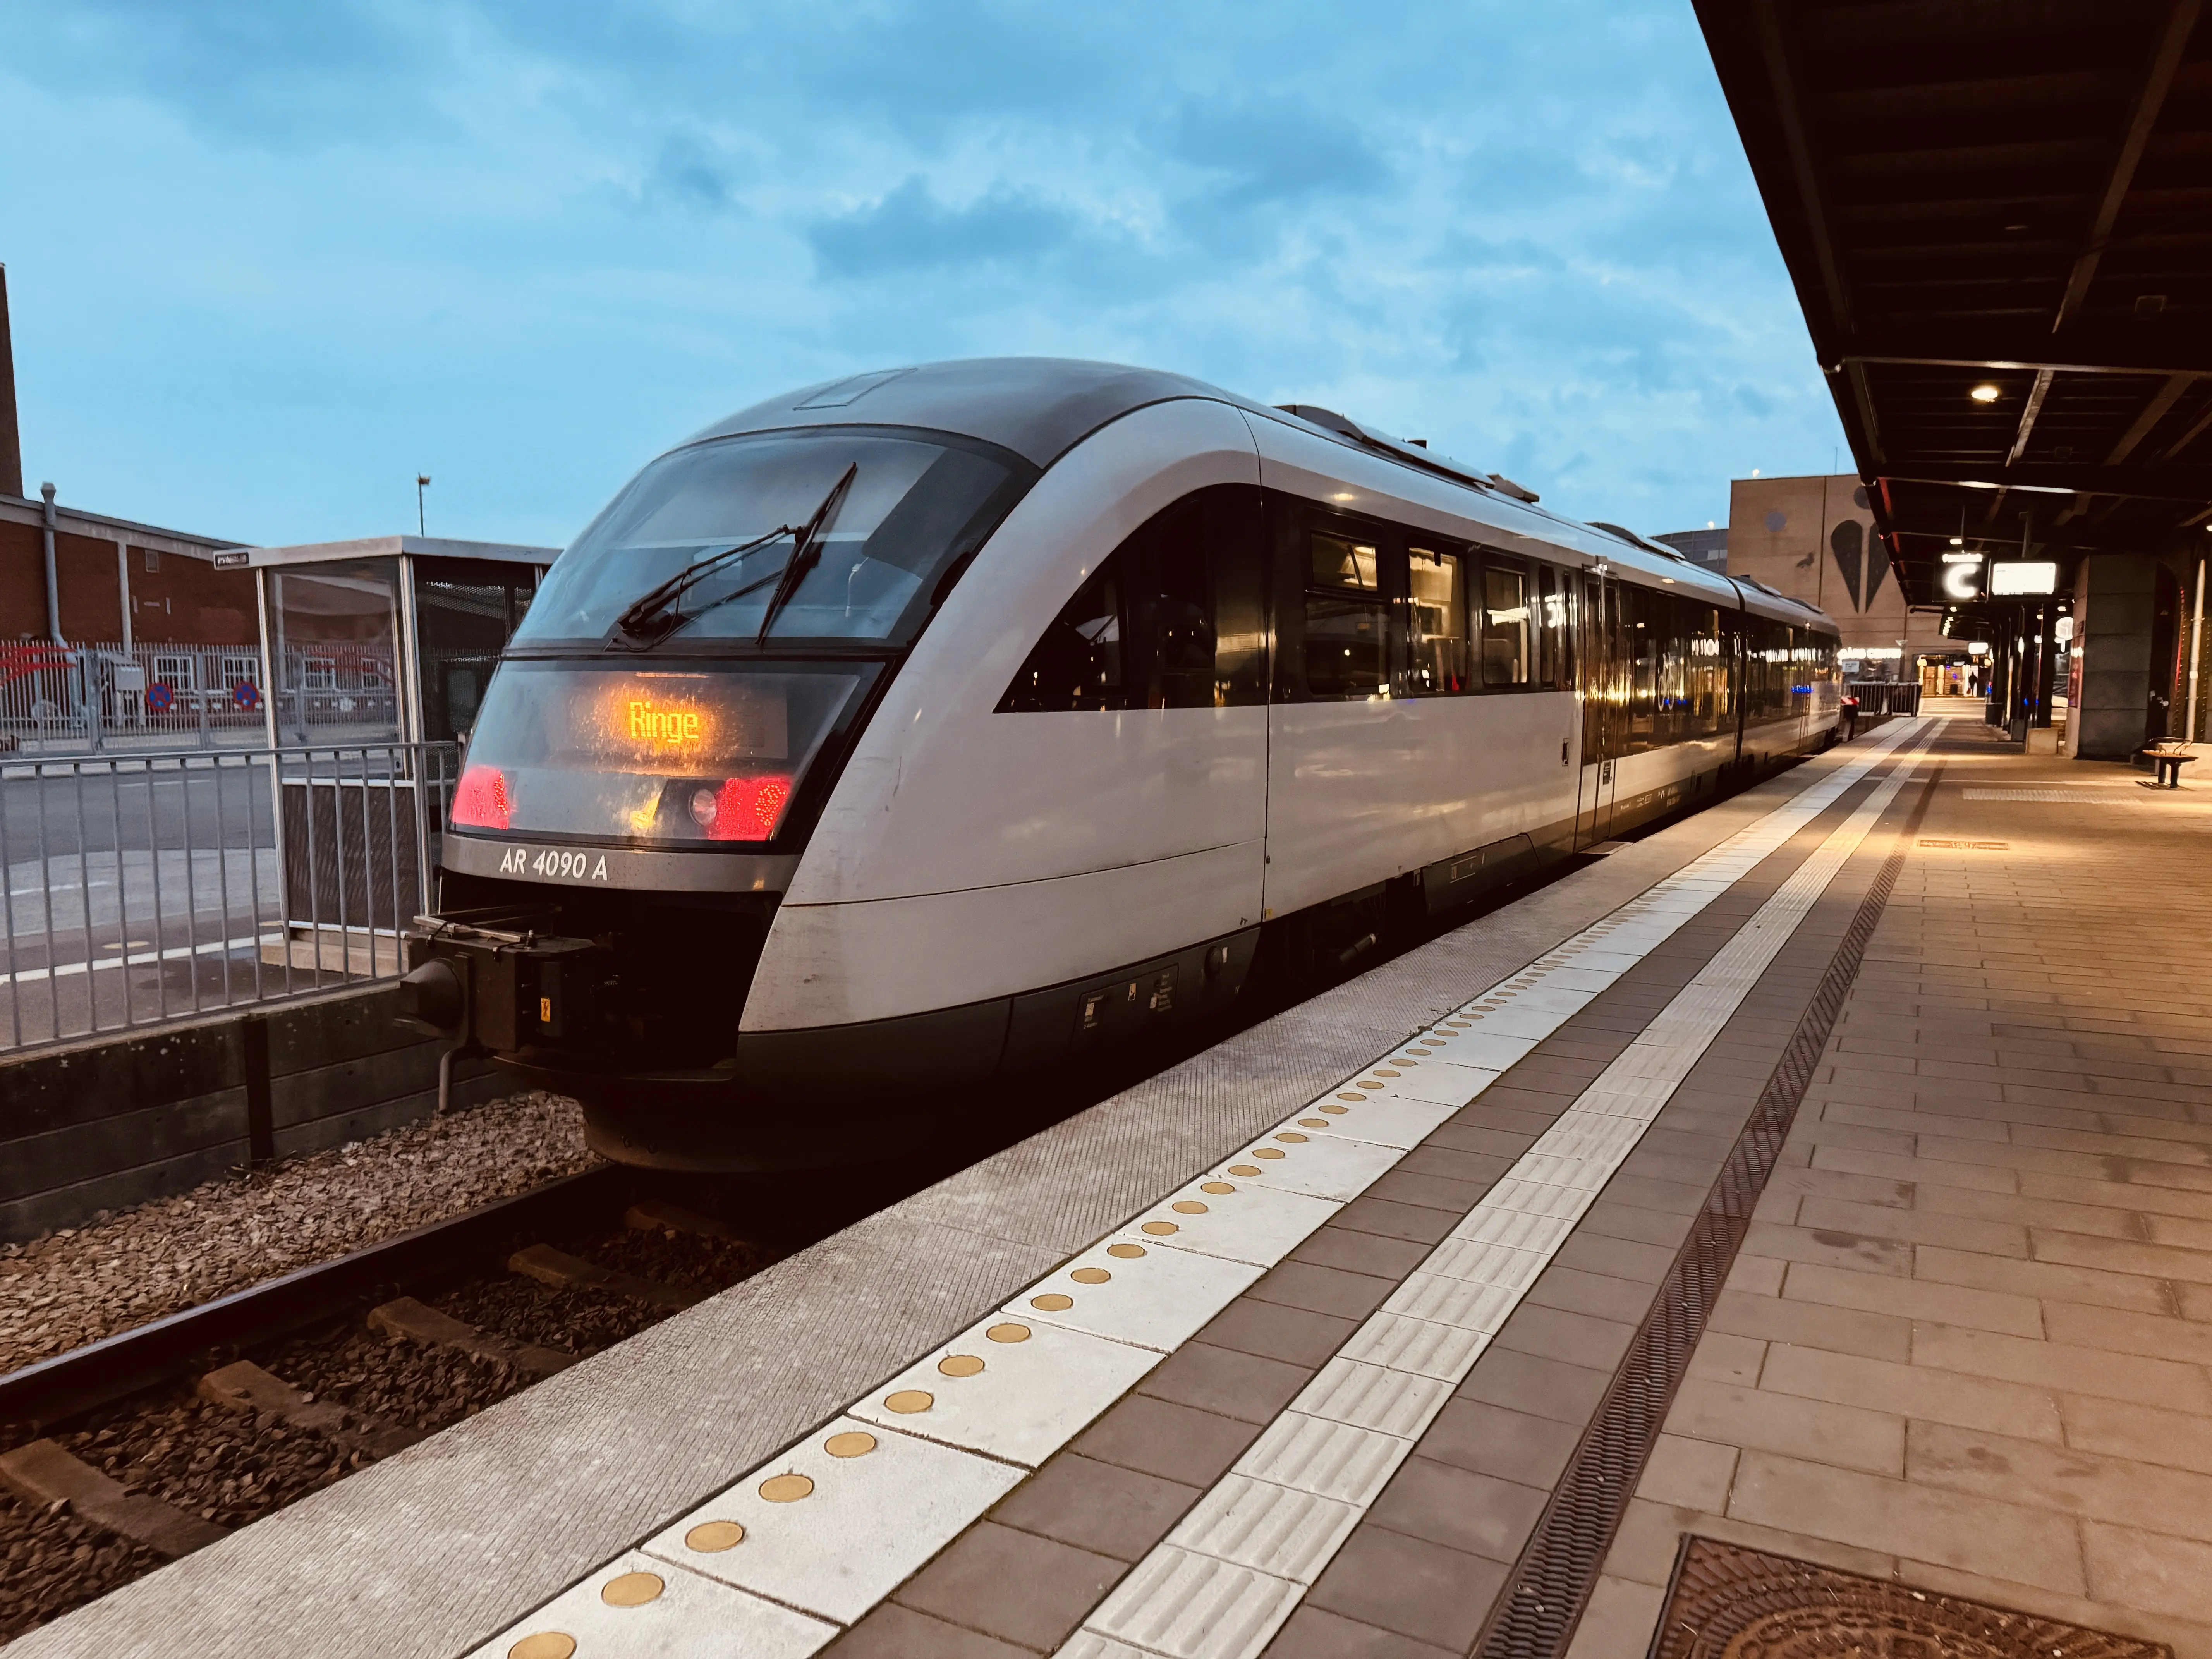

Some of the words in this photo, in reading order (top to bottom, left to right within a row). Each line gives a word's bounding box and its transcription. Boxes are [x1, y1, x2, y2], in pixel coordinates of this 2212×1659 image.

[1946, 563, 1977, 598] C
[630, 702, 699, 743] Ringe
[499, 848, 527, 874] AR
[532, 850, 586, 879] 4090
[591, 855, 608, 881] A
